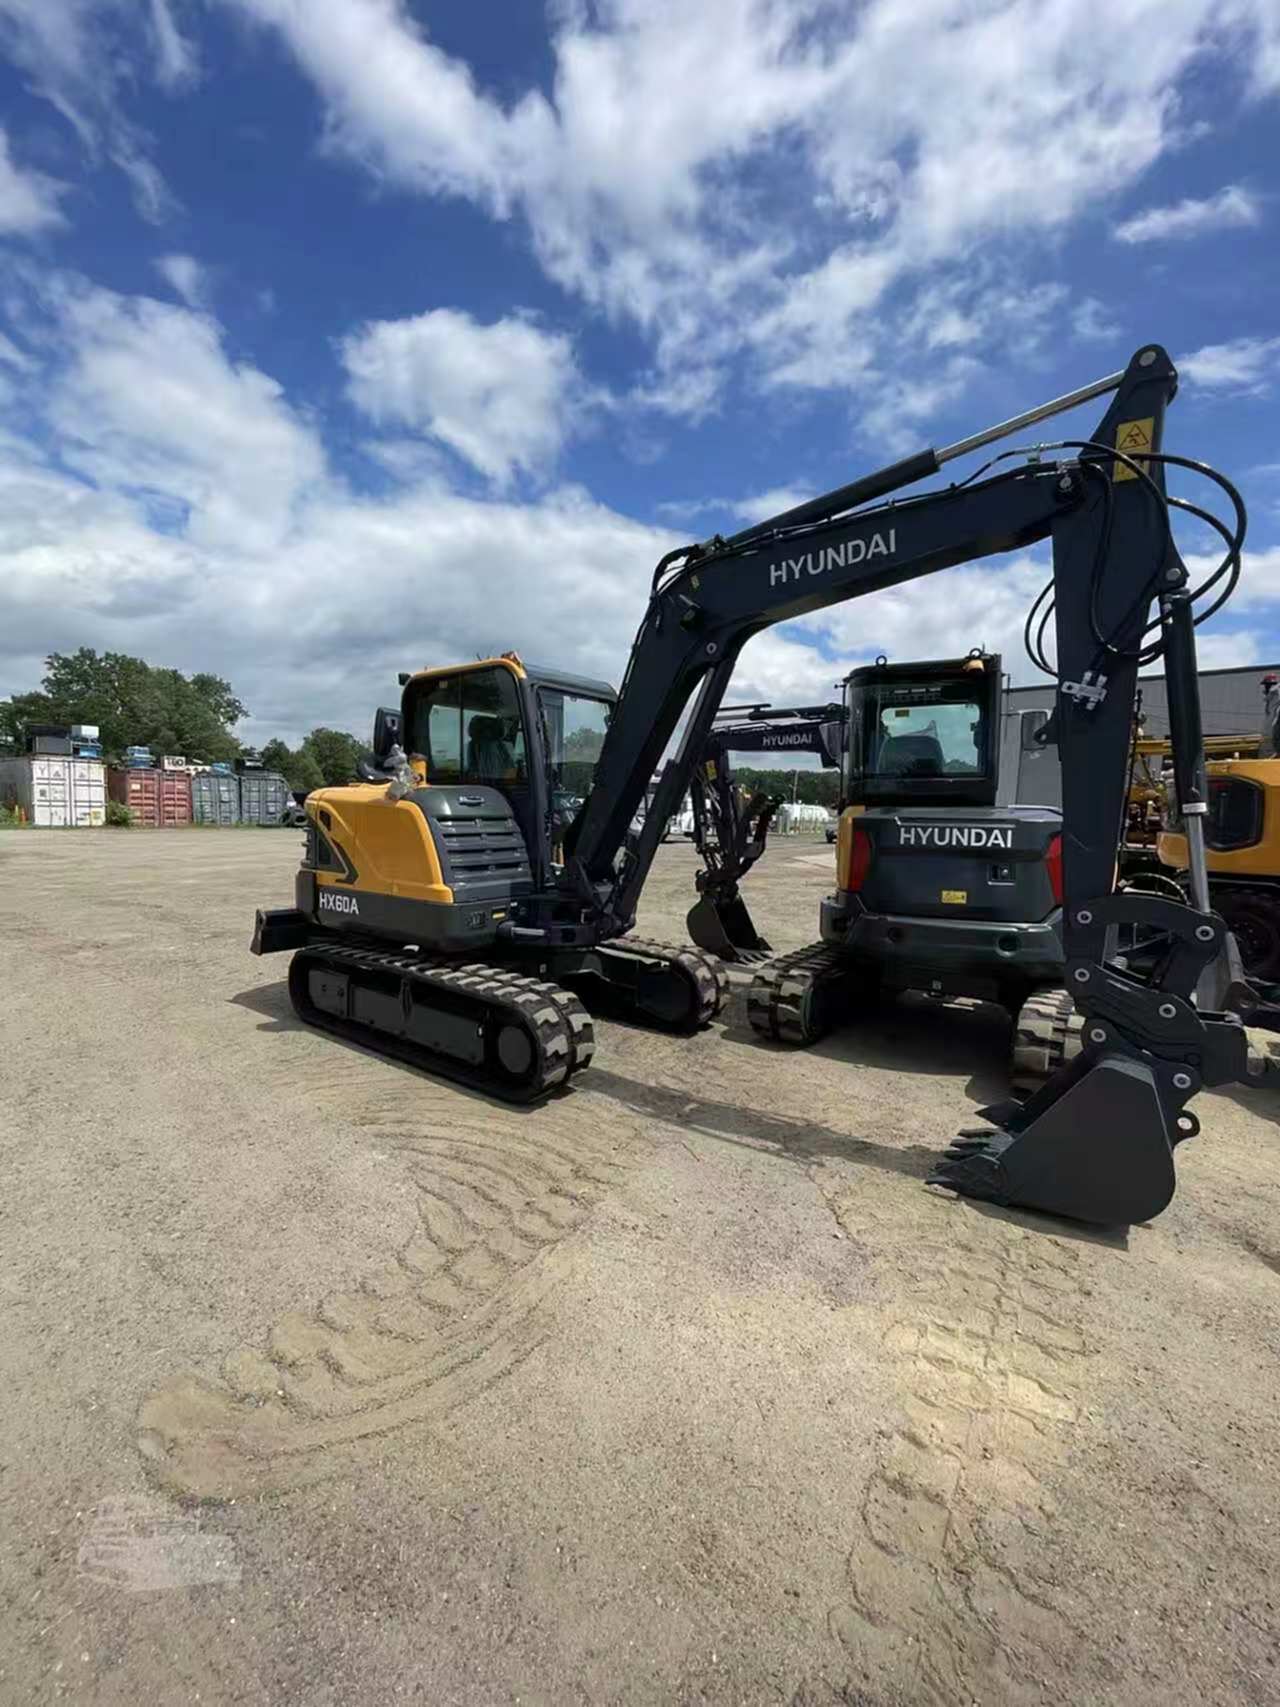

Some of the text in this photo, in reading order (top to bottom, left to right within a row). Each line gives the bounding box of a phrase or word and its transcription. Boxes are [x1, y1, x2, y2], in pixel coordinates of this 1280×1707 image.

[769, 528, 896, 586] HYUNDAI
[762, 733, 812, 746] HYUNDAI
[899, 827, 1013, 848] HYUNDAI
[319, 891, 360, 915] HX60A
